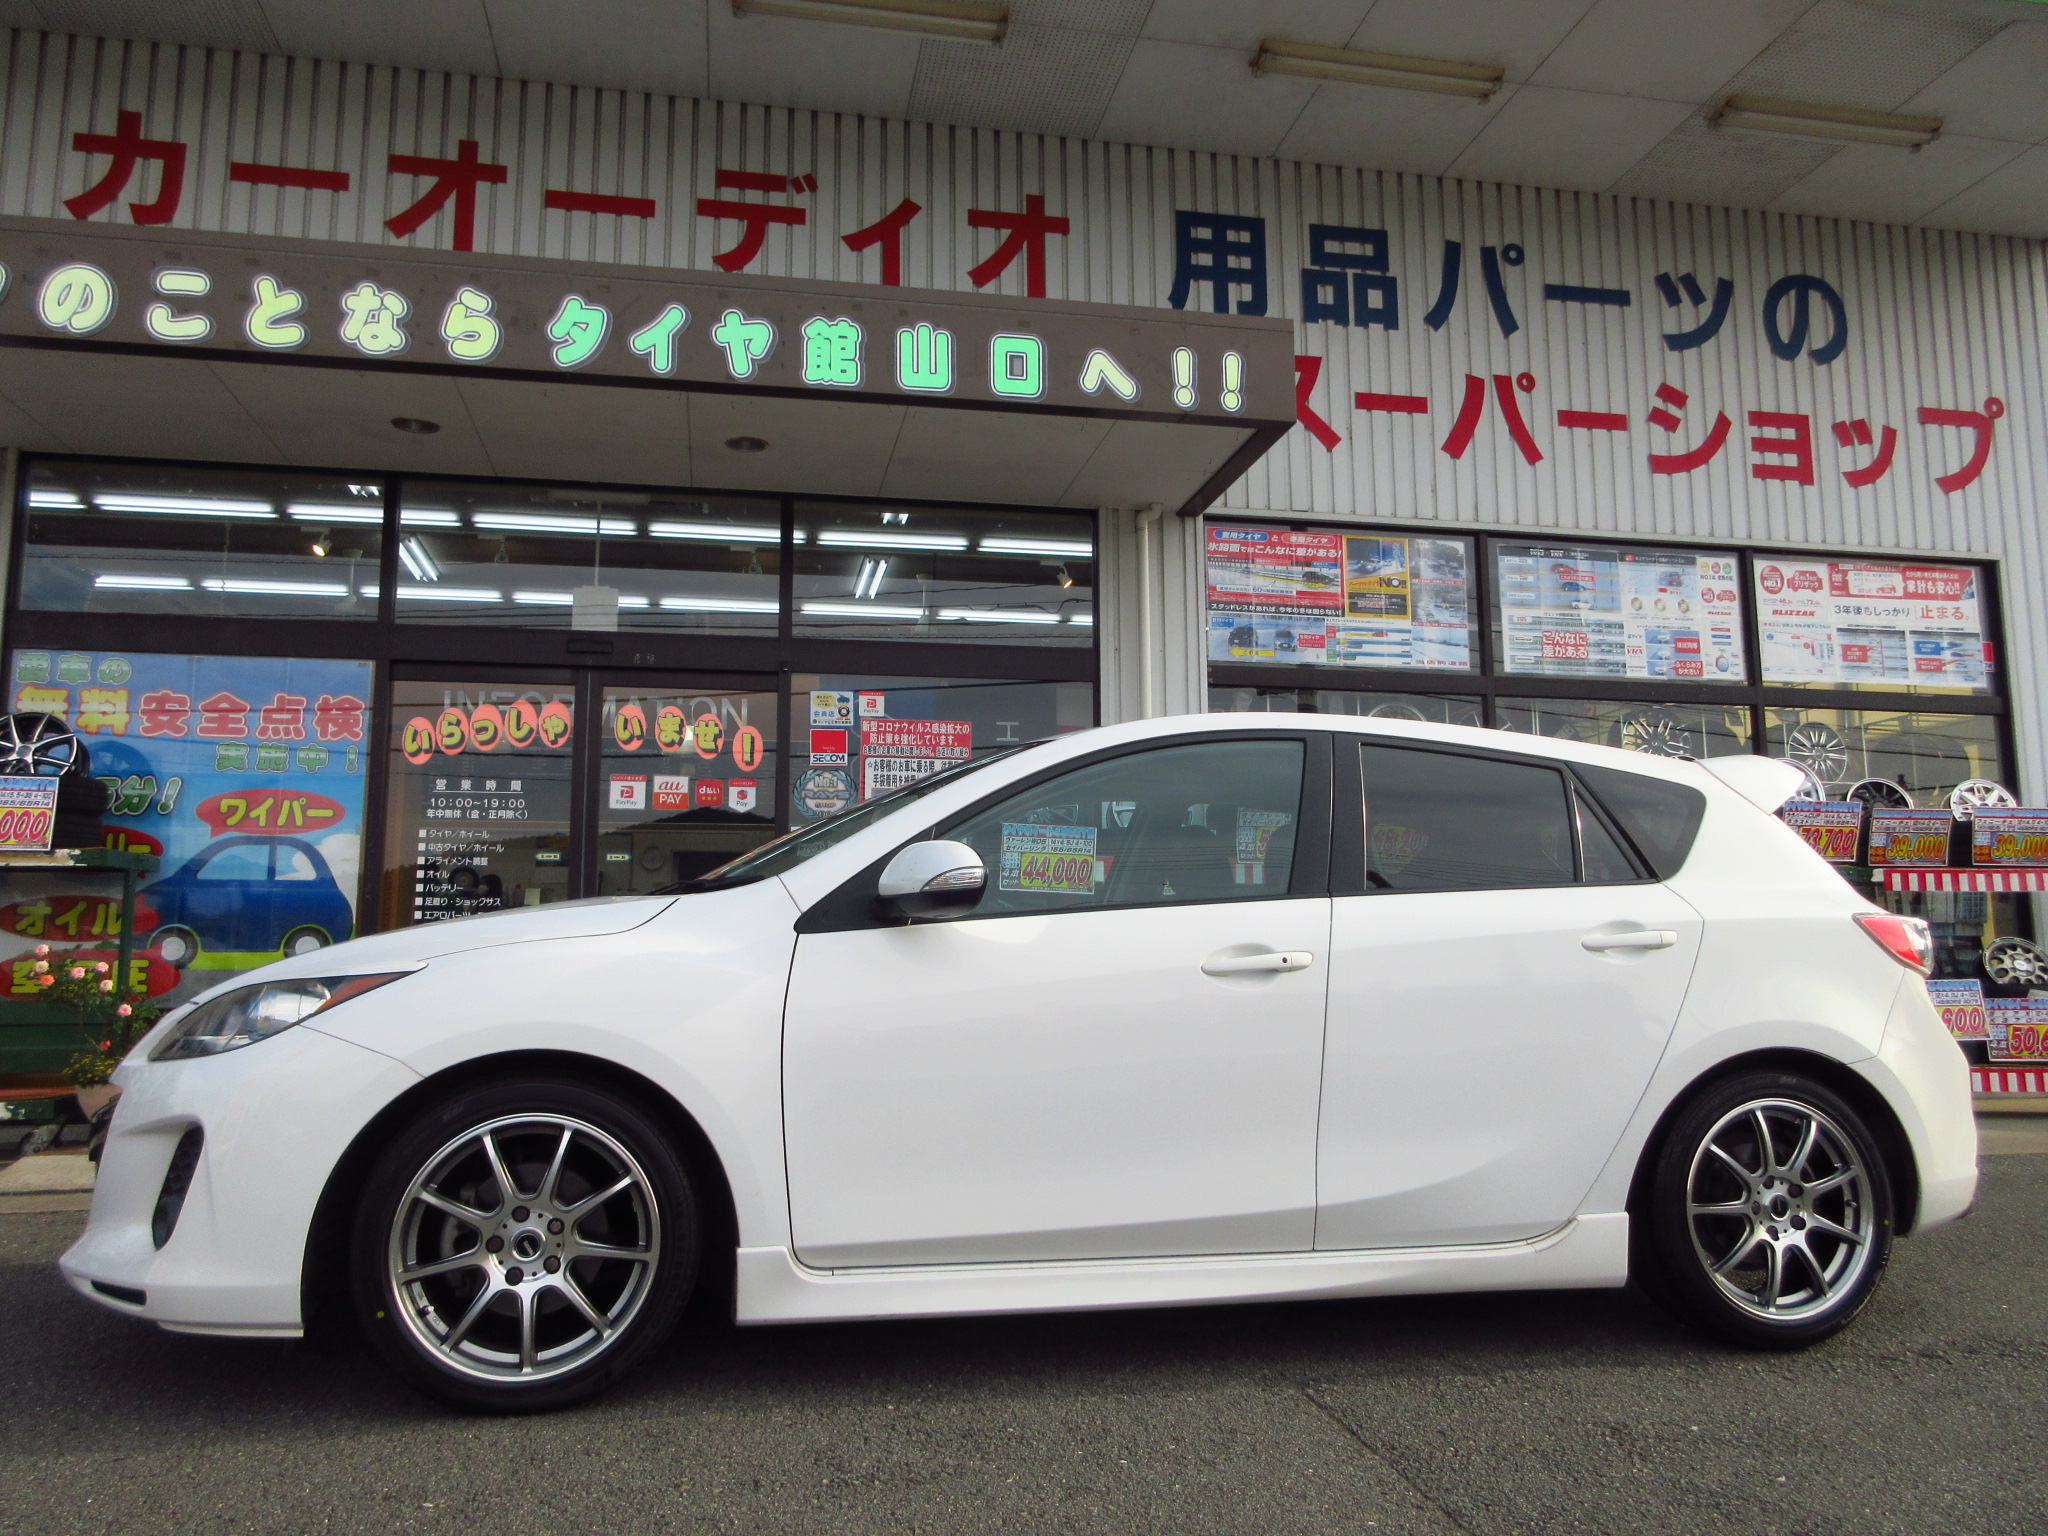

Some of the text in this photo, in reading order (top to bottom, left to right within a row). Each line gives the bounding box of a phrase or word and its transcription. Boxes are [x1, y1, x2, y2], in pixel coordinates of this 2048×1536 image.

[63, 111, 1849, 365] カーオーディオ 用品パーツの
[0, 262, 1249, 413] のことならタイヤ館山口へ!!
[1793, 581, 1819, 589] ブリザック
[1906, 579, 1960, 595] 家計も安心!!
[1772, 609, 1816, 617] BLIZZAK
[1834, 603, 1971, 621] 3年後もしっかり 止まる。
[1542, 631, 1588, 645] こんなに
[1542, 645, 1588, 659] 差がある
[15, 652, 132, 685] 愛車の
[14, 684, 365, 742] 無料安全点検
[862, 721, 970, 735] 新型コロナウイルス感染拡大の
[869, 733, 959, 746] 防止策を強化しています。
[215, 740, 359, 774] 実施中!
[812, 753, 845, 763] SECOM
[436, 778, 522, 791] 営業時間
[658, 780, 685, 791] au
[659, 794, 683, 804] PAY
[801, 789, 850, 800] RAYS
[219, 797, 335, 828] ワイパー
[1886, 834, 1948, 861] 39,000
[426, 856, 489, 866] アライメント調整
[426, 870, 450, 879] オイル
[1021, 855, 1092, 887] 44,000
[425, 883, 464, 893] バッテリー
[15, 900, 123, 936] オイル
